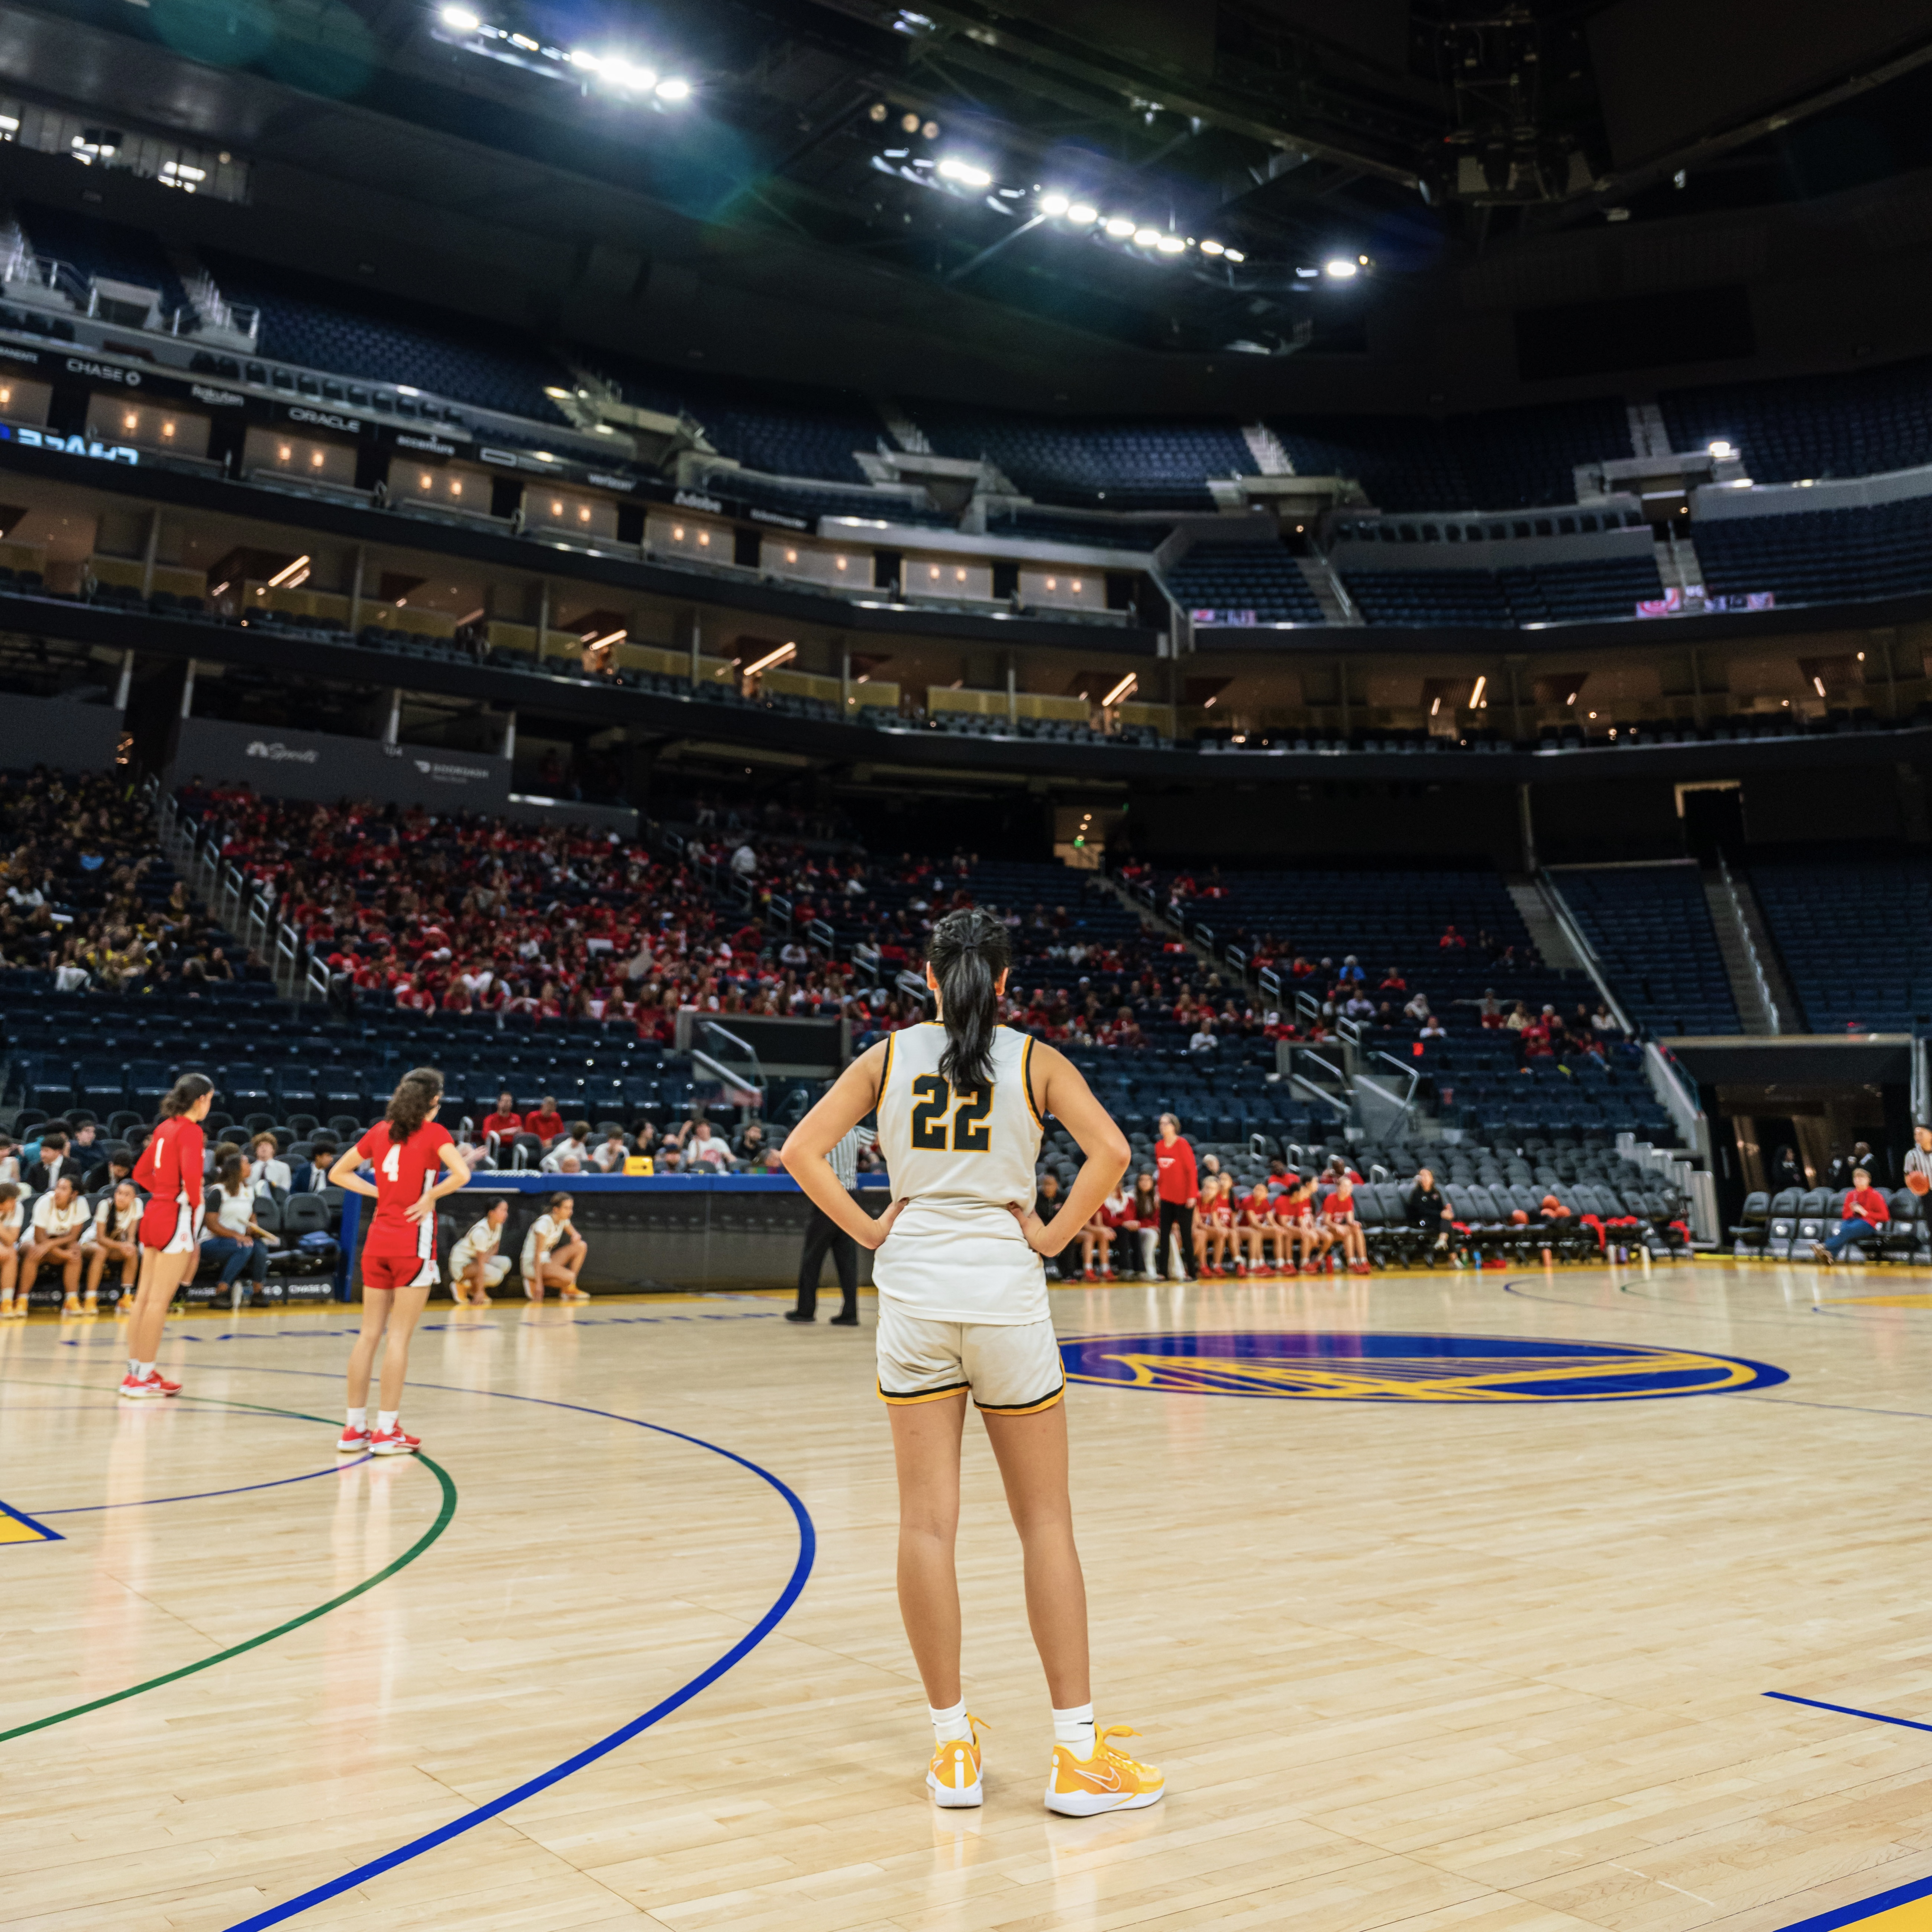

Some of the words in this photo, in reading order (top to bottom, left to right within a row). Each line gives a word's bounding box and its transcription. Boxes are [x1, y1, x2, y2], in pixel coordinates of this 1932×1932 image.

[66, 358, 123, 382] CHASE
[288, 407, 361, 433] ORACLE
[911, 1073, 995, 1153] 22
[154, 1138, 164, 1169] 1
[382, 1144, 401, 1182] 4
